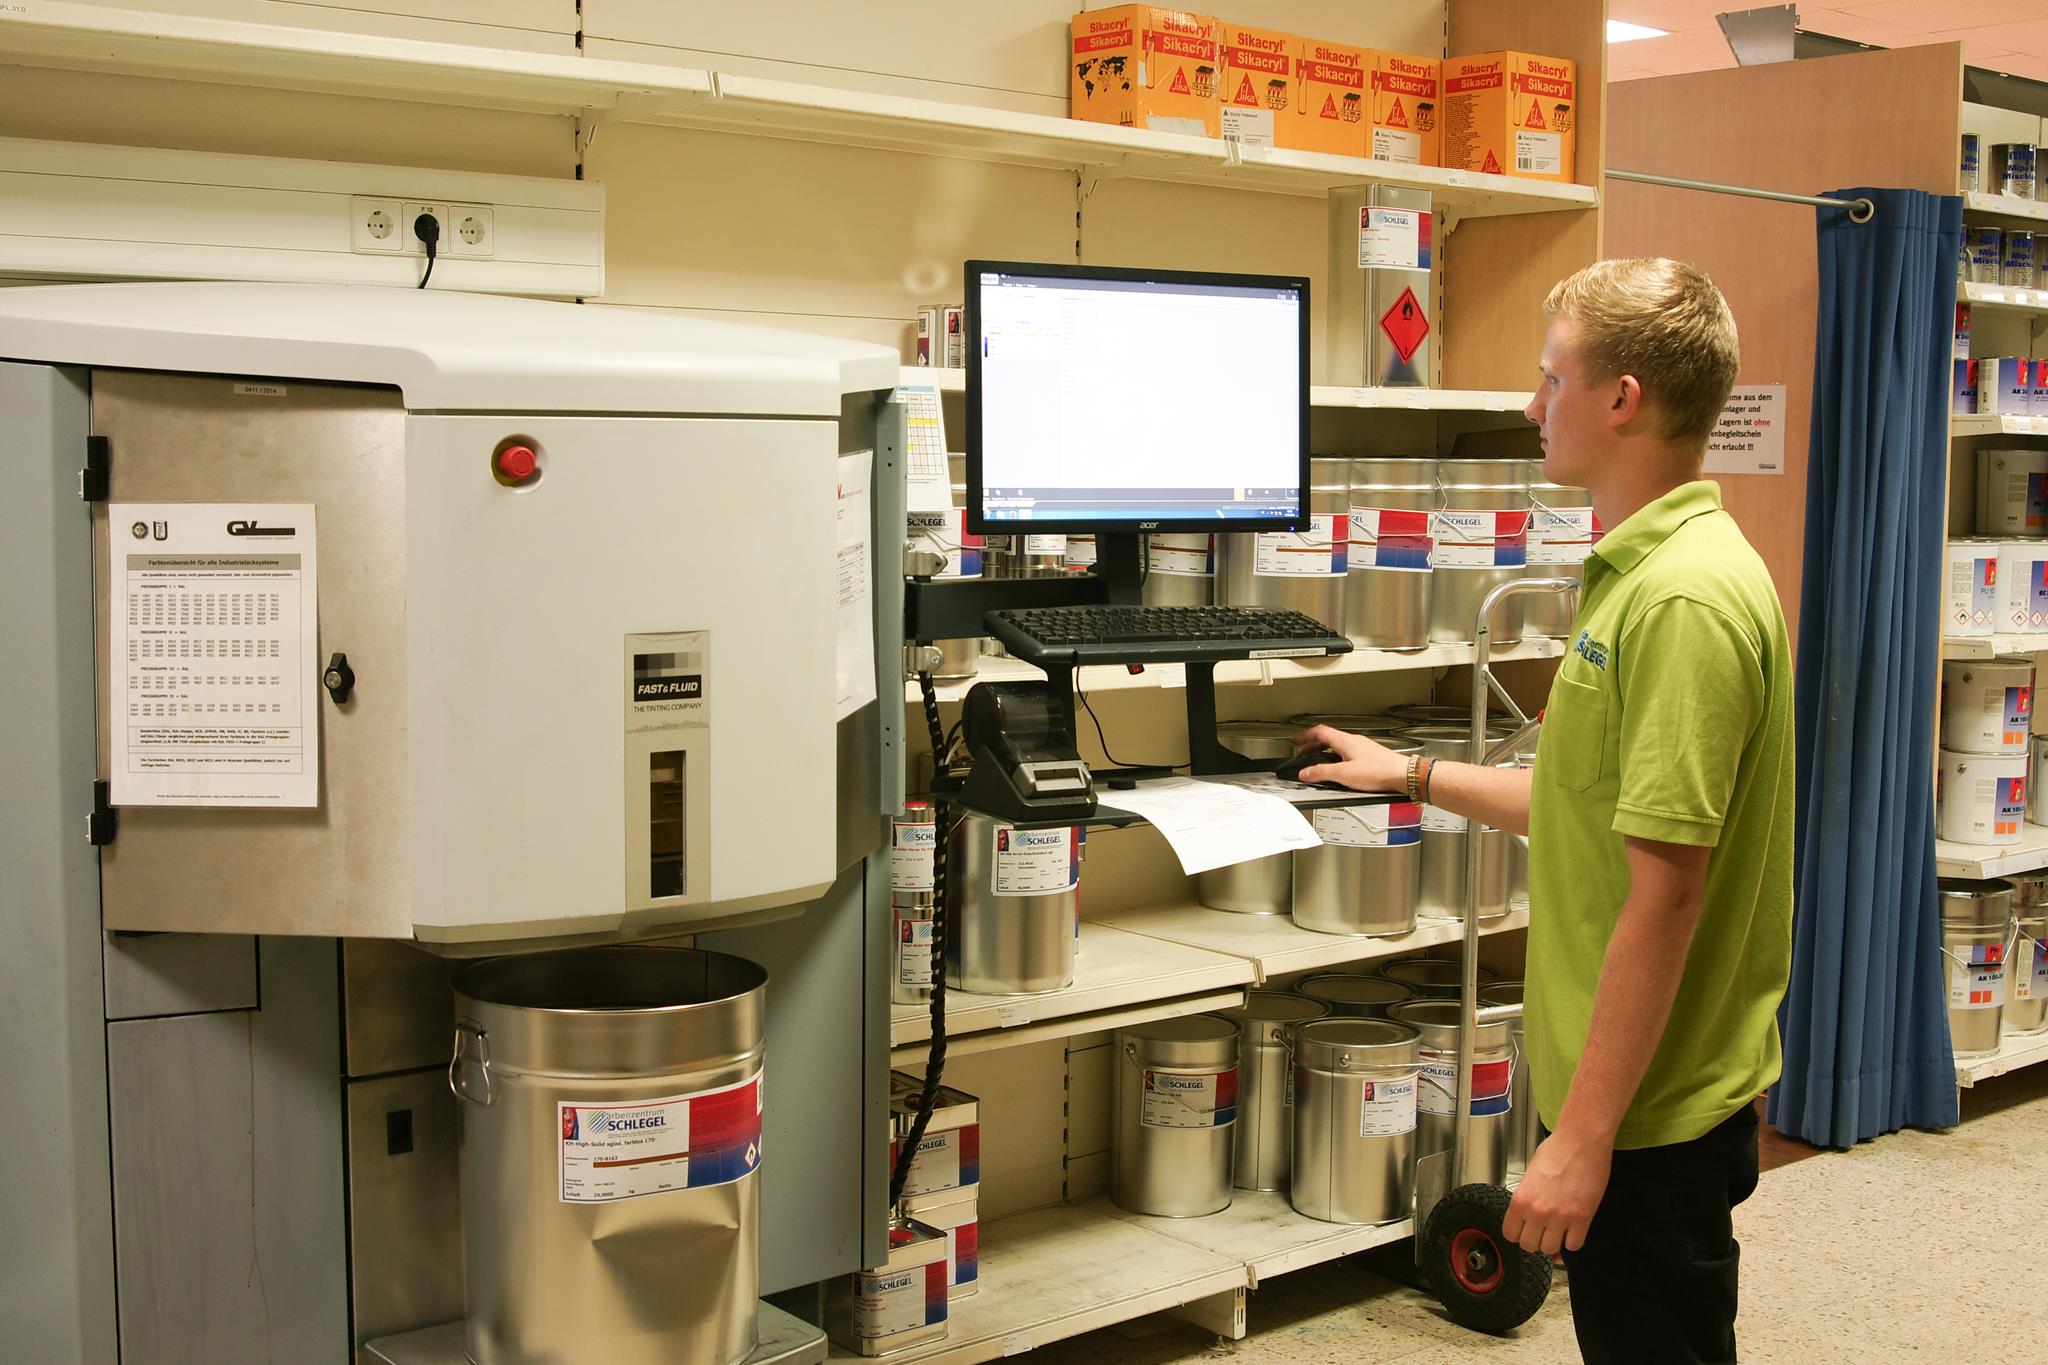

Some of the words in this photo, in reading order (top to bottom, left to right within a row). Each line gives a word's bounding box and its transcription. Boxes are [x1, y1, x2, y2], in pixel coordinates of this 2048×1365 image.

[1089, 18, 1128, 33] Sikacryl
[1090, 34, 1128, 48] Sikacryl
[1163, 37, 1212, 58] Sikacryl
[1238, 32, 1283, 52] Sikacryl
[1237, 51, 1283, 71] Sikacryl
[1315, 47, 1360, 67] Sikacryl
[1315, 65, 1360, 84] Sikacryl
[1390, 59, 1432, 77] Sikacryl
[1461, 62, 1497, 76] Sikacryl
[1528, 61, 1568, 78] Sikacryl
[1389, 76, 1431, 96] Sikacryl
[1461, 76, 1498, 89] Sikacryl
[1528, 78, 1568, 96] Sikacryl
[1237, 83, 1256, 104] Sika
[1389, 105, 1407, 126] Sika
[1758, 393, 1772, 401] dem
[1724, 405, 1746, 414] nlager
[1711, 431, 1761, 439] enbegleitschein
[1722, 443, 1745, 451] erlaubt
[1139, 521, 1159, 530] acer
[638, 684, 663, 695] FAST
[669, 682, 699, 694] FLUID
[646, 704, 670, 712] TINTING
[671, 702, 703, 711] COMPANY
[1026, 836, 1061, 846] SCHLEGEL
[1421, 1065, 1455, 1077] SCHLEGEL
[1169, 1081, 1205, 1089] SCHLEGEL
[601, 1108, 665, 1120] Farbenzentrum
[607, 1116, 667, 1132] SCHLEGEL
[878, 1277, 913, 1292] SCHLEGEL
